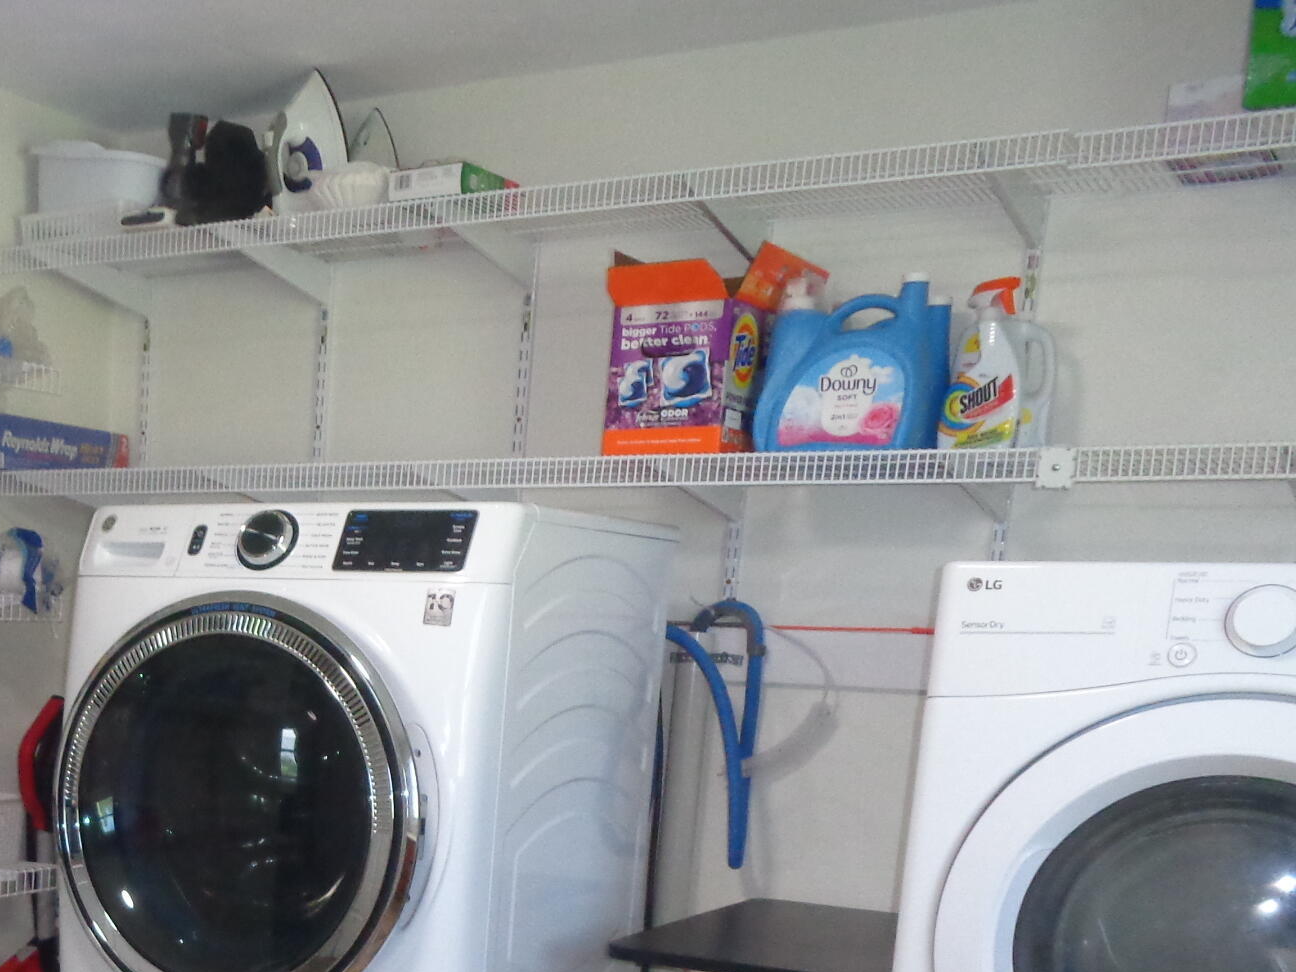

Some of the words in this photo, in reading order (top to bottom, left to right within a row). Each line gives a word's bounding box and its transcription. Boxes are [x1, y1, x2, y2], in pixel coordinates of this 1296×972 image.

[655, 311, 669, 320] 72
[622, 327, 657, 338] bigger
[660, 324, 681, 334] Tide
[732, 333, 757, 372] Tide
[820, 376, 877, 396] Downy
[660, 408, 689, 418] ODOR
[2, 430, 50, 453] Reynolds
[51, 437, 78, 460] Wrap
[985, 579, 1003, 590] LG
